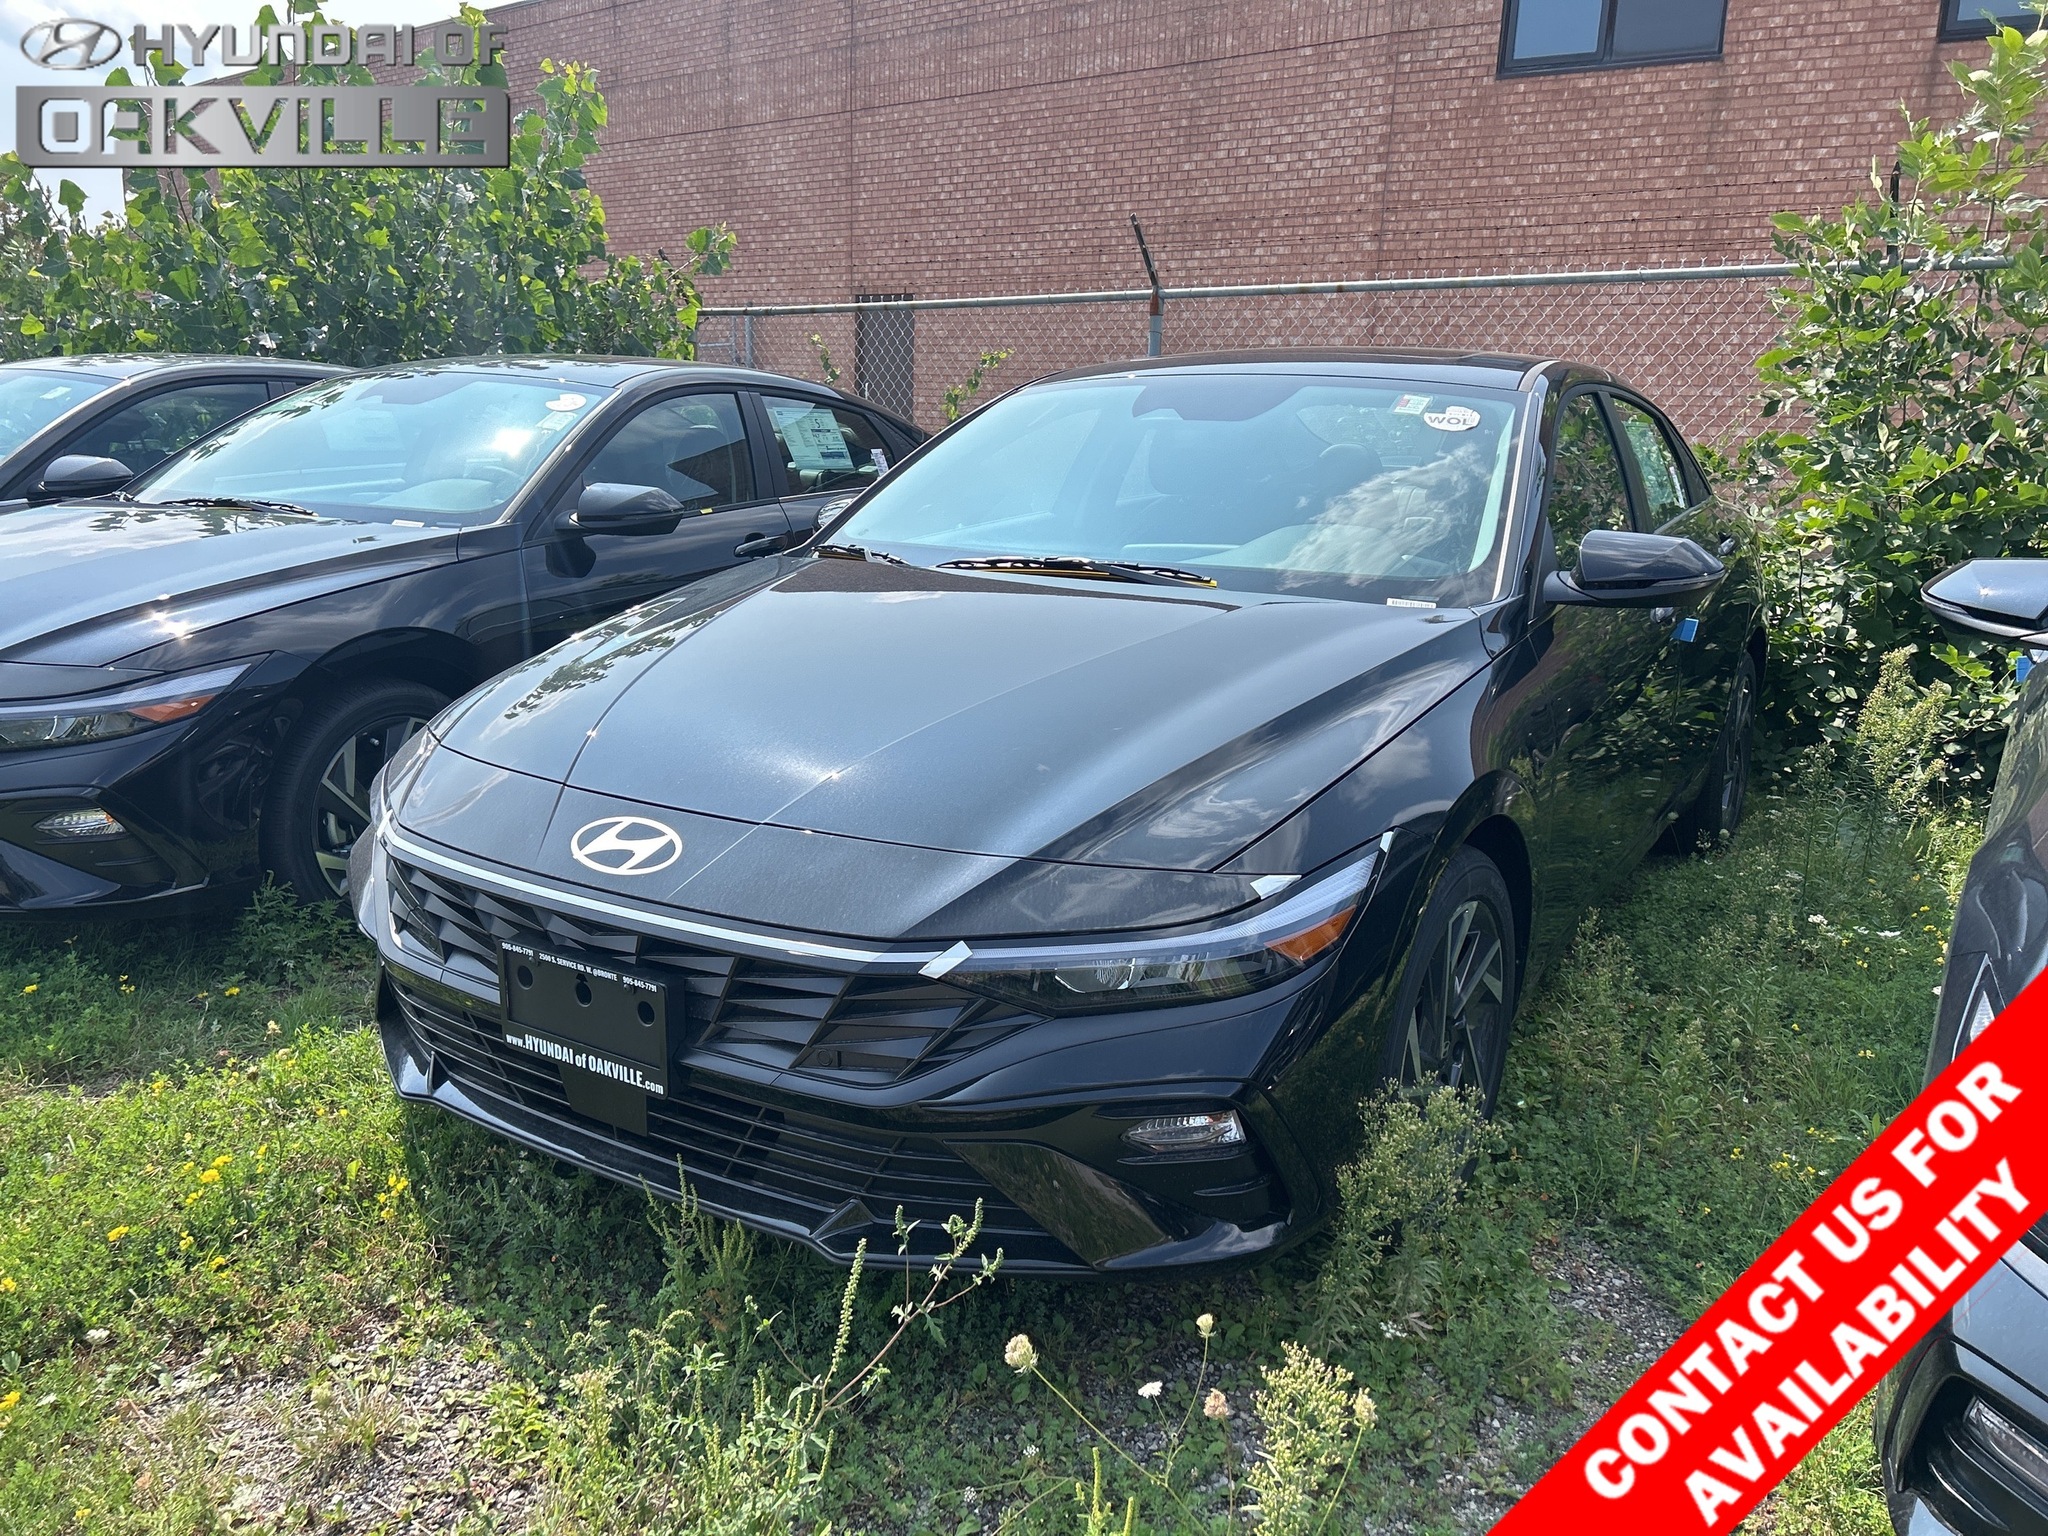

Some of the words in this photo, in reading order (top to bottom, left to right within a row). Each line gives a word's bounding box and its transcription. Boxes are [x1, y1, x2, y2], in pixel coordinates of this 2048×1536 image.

[501, 942, 534, 957] 905-845-7791
[538, 952, 551, 962] 2500
[557, 957, 577, 970] SERVICE
[622, 976, 658, 993] 905-845-7791
[505, 1033, 574, 1065] www.HYUNDAI
[575, 1053, 587, 1069] of
[588, 1055, 664, 1095] OAKVILLE.com
